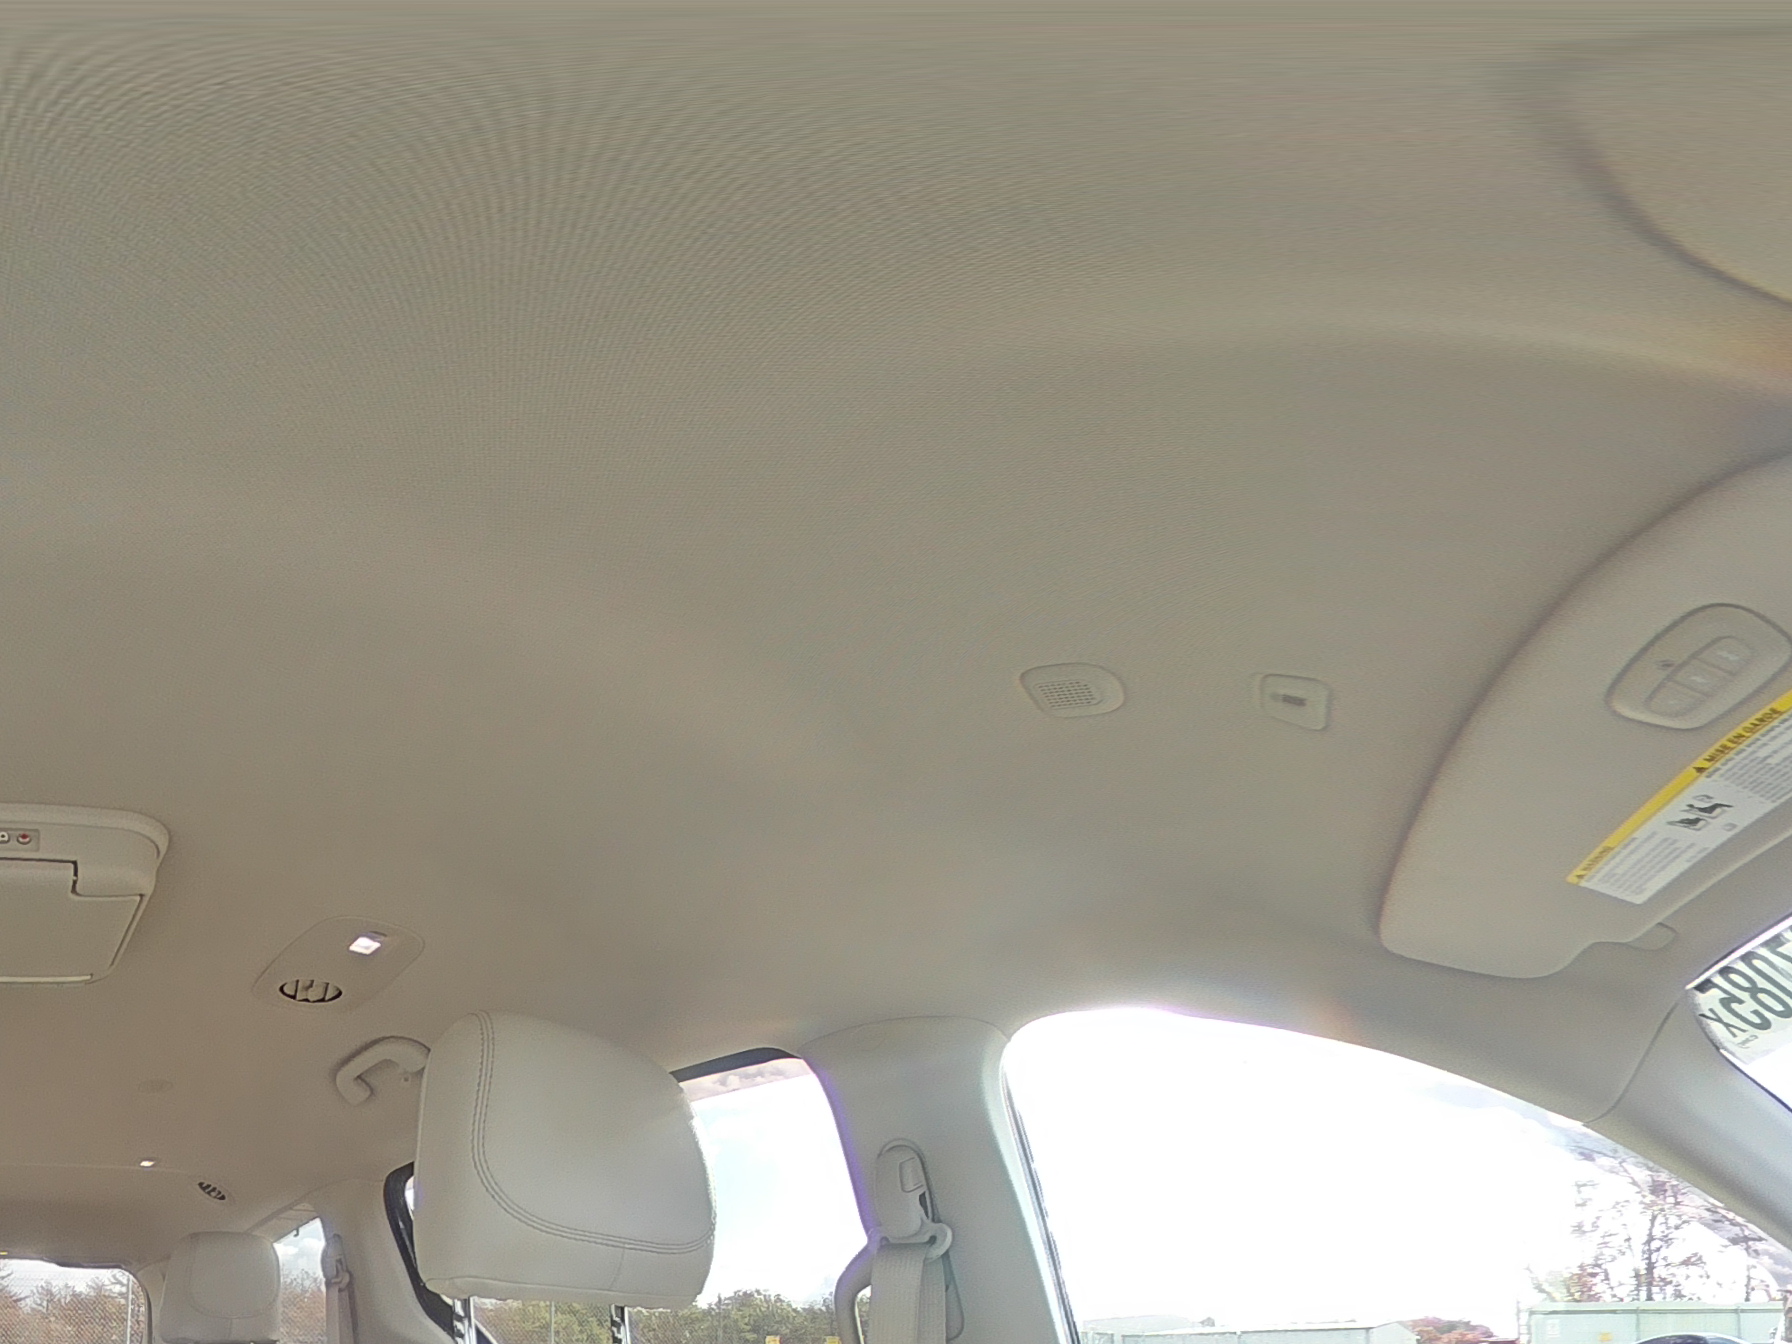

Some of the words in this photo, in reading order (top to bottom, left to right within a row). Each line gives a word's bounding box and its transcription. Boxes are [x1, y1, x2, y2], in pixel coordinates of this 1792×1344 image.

[1703, 743, 1731, 763] MISE
[1726, 732, 1747, 746] EN
[1742, 707, 1782, 734] GARDE
